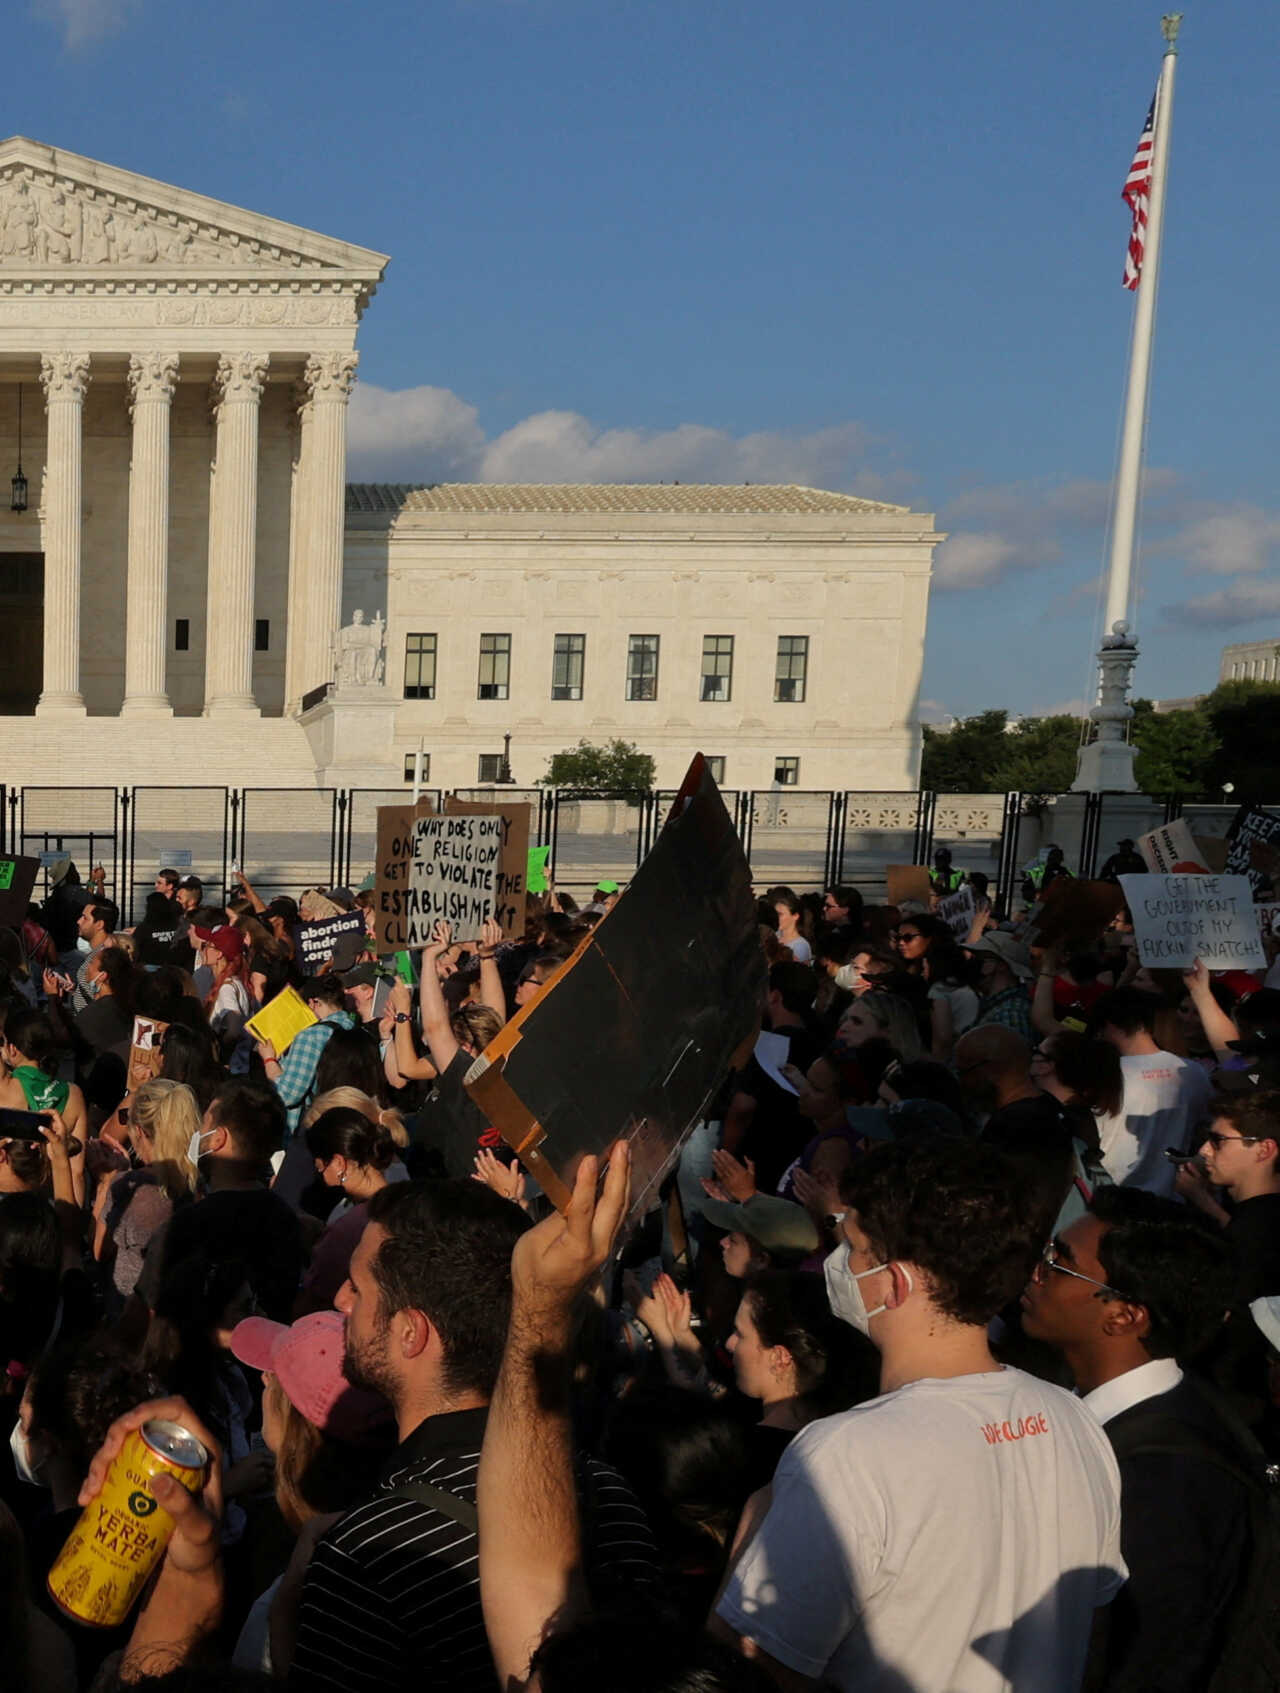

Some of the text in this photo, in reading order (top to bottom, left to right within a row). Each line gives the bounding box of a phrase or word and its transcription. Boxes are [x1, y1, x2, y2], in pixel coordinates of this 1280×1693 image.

[418, 816, 512, 846] WHY DOES ONLY
[1161, 829, 1178, 860] RIGHT
[392, 836, 498, 863] ONE RELIGION
[1150, 835, 1169, 873] DECISIO
[384, 862, 522, 895] GET TO VIOLATE THE
[1166, 876, 1220, 898] GET THE
[381, 888, 516, 929] ESTABLISHMENT
[300, 919, 359, 940] abortion
[385, 918, 460, 943] CLAUS?
[1211, 919, 1233, 934] MY
[301, 935, 338, 952] finde
[304, 949, 333, 962] .org
[98, 1503, 157, 1552] YERBA
[94, 1525, 146, 1563] MATE
